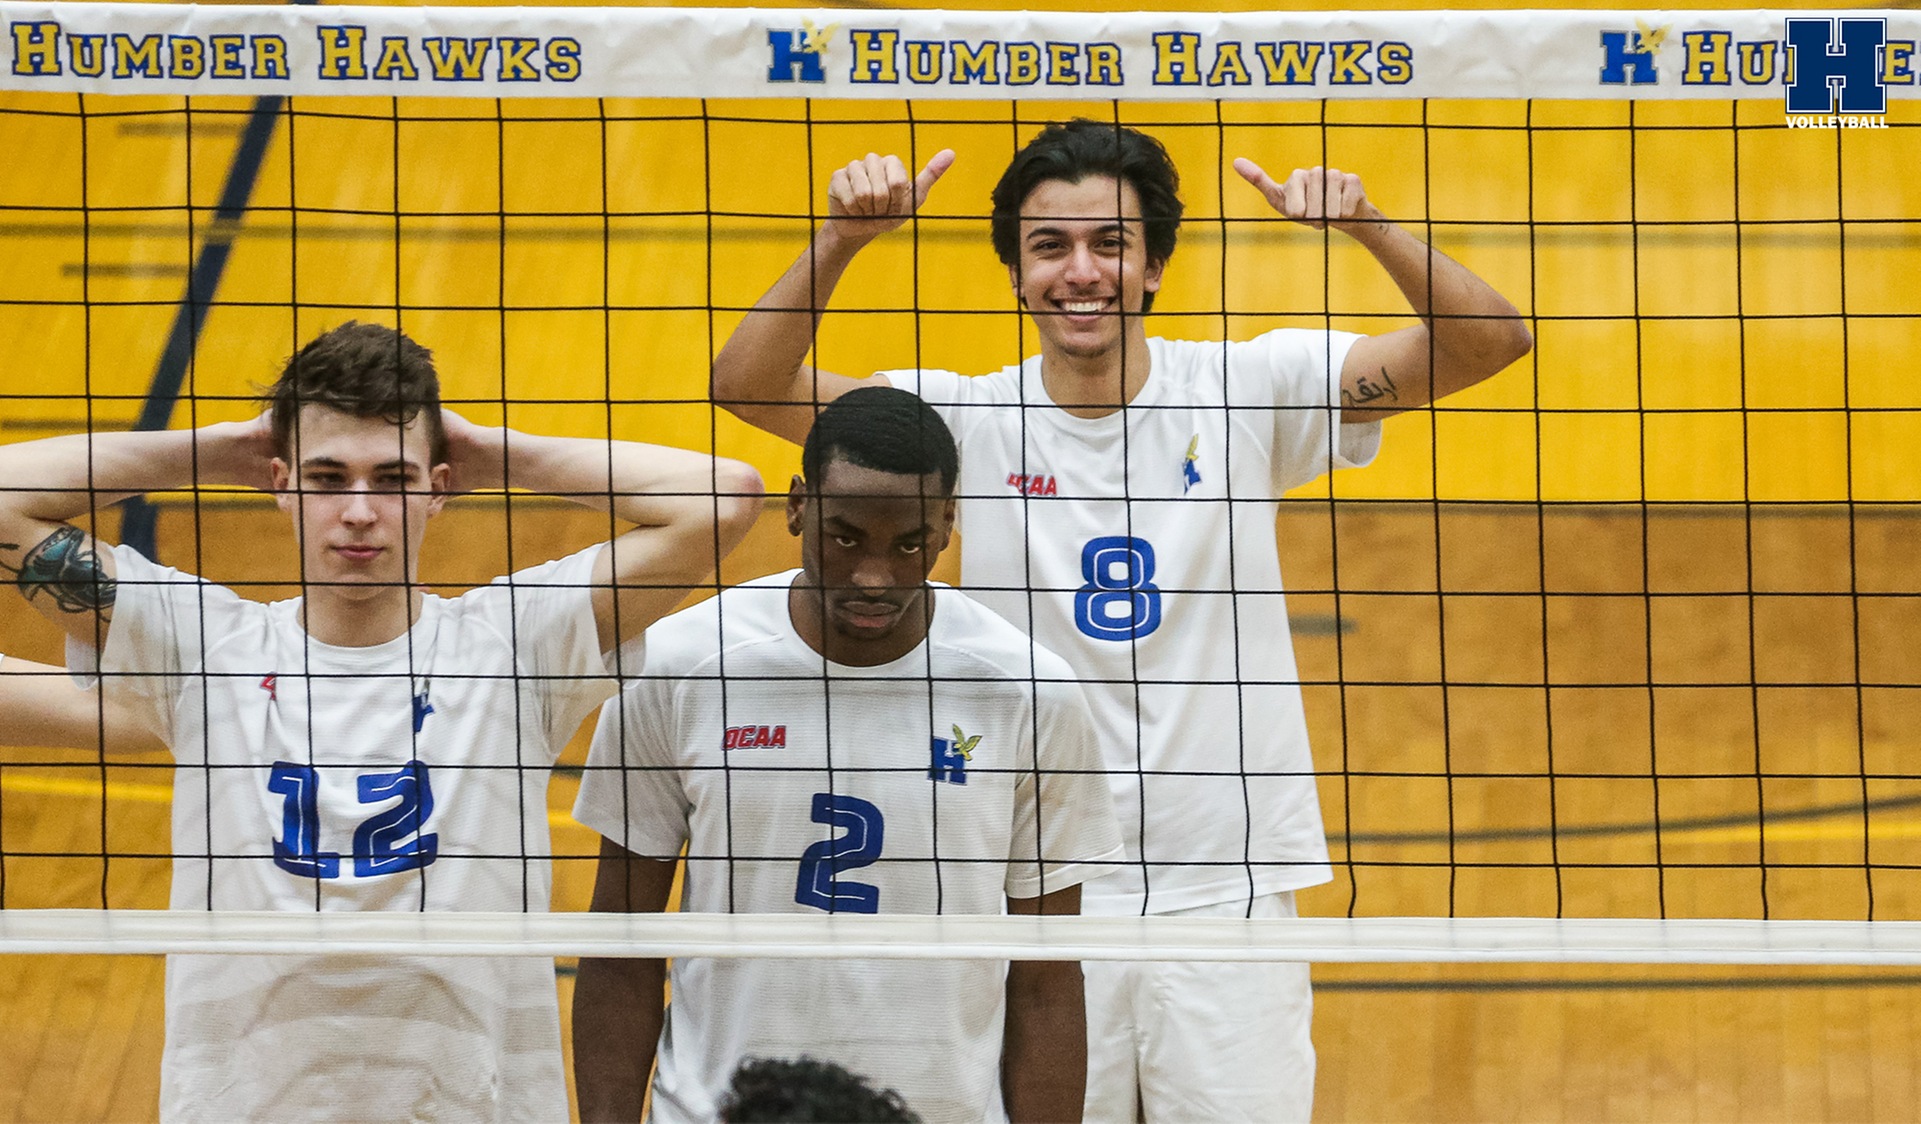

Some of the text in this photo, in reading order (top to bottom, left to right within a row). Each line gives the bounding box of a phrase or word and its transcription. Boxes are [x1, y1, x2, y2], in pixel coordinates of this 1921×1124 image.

[10, 21, 582, 83] HUMBER HAWKS
[850, 29, 1124, 86] HUMBER
[1151, 30, 1414, 86] HAWKS
[1682, 30, 1921, 86] HUE
[1074, 536, 1161, 641] 8
[721, 725, 786, 750] OCAA
[268, 760, 438, 879] 12
[795, 793, 884, 914] 2
